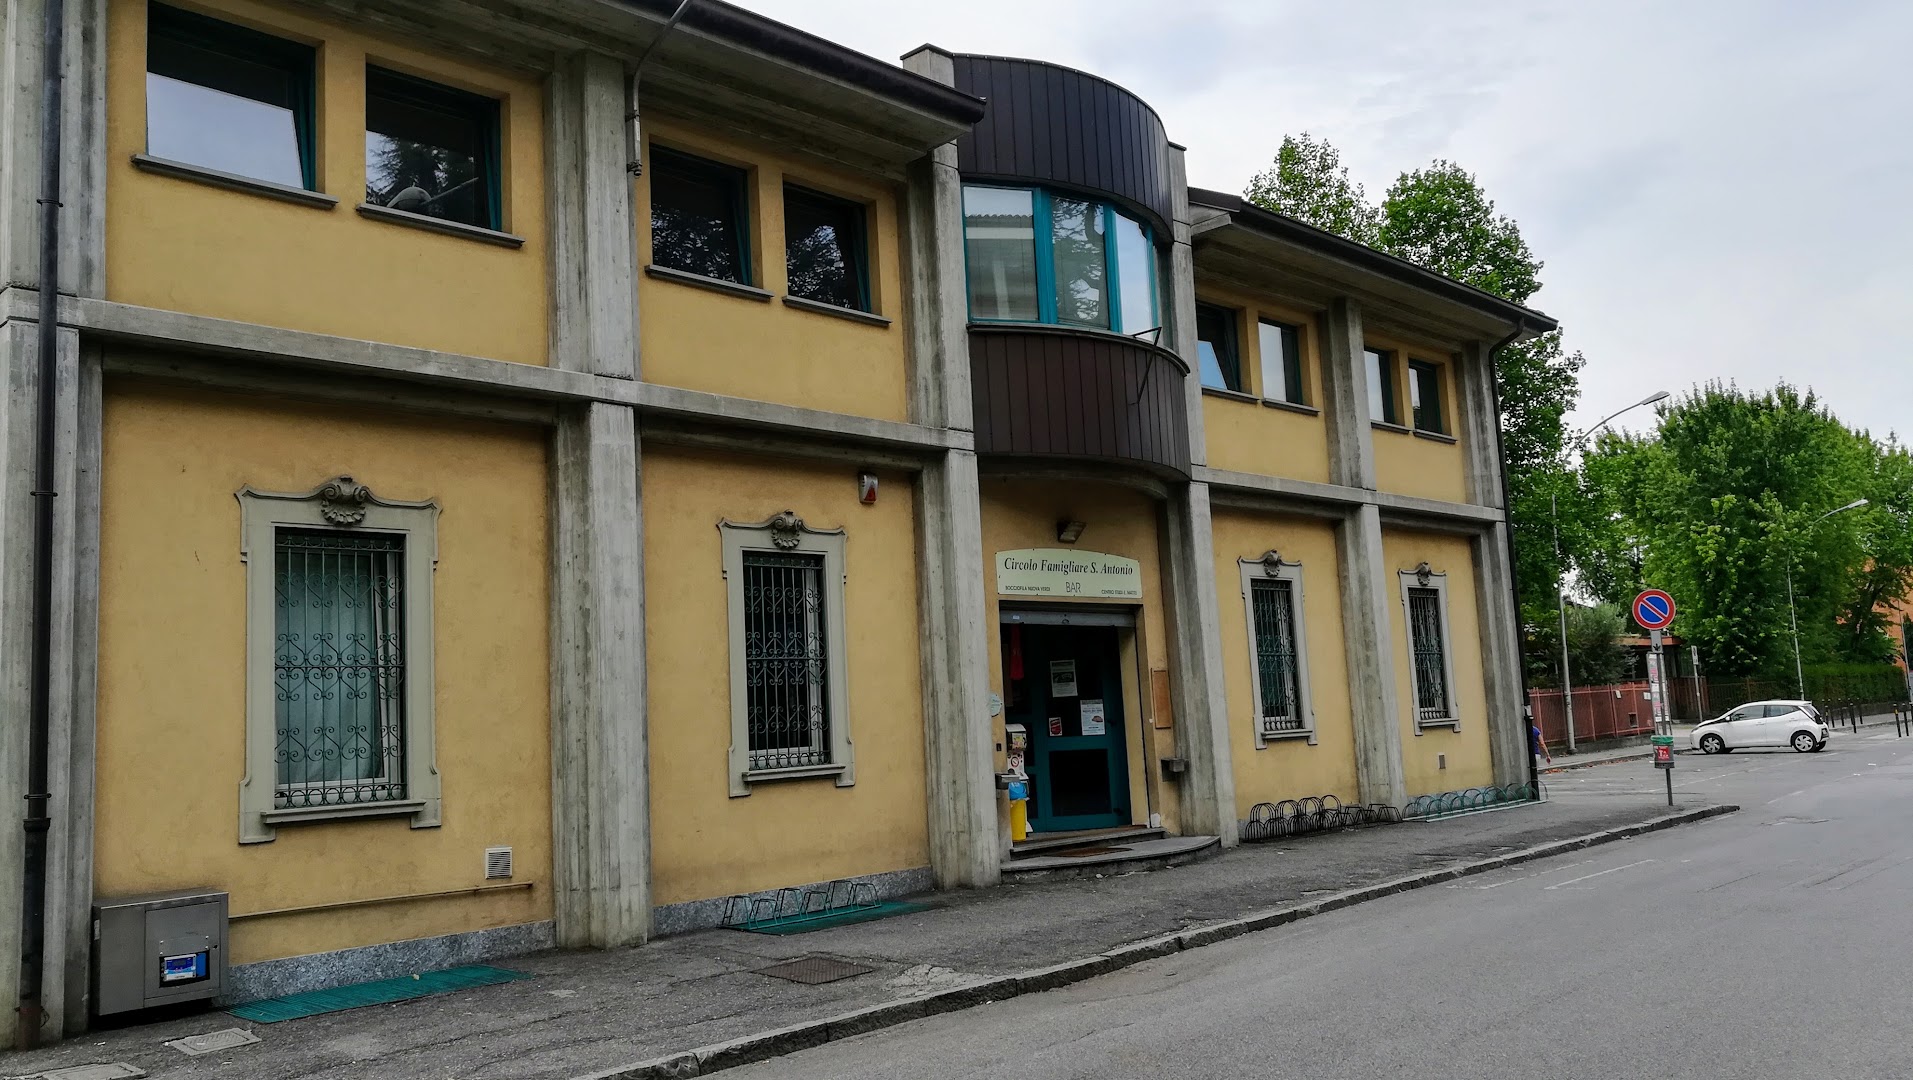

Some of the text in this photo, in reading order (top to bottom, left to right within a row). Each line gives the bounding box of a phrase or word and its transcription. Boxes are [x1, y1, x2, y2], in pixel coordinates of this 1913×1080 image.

[1004, 557, 1133, 576] Circolo Famigliare S. Antonio
[1065, 581, 1082, 593] BAR
